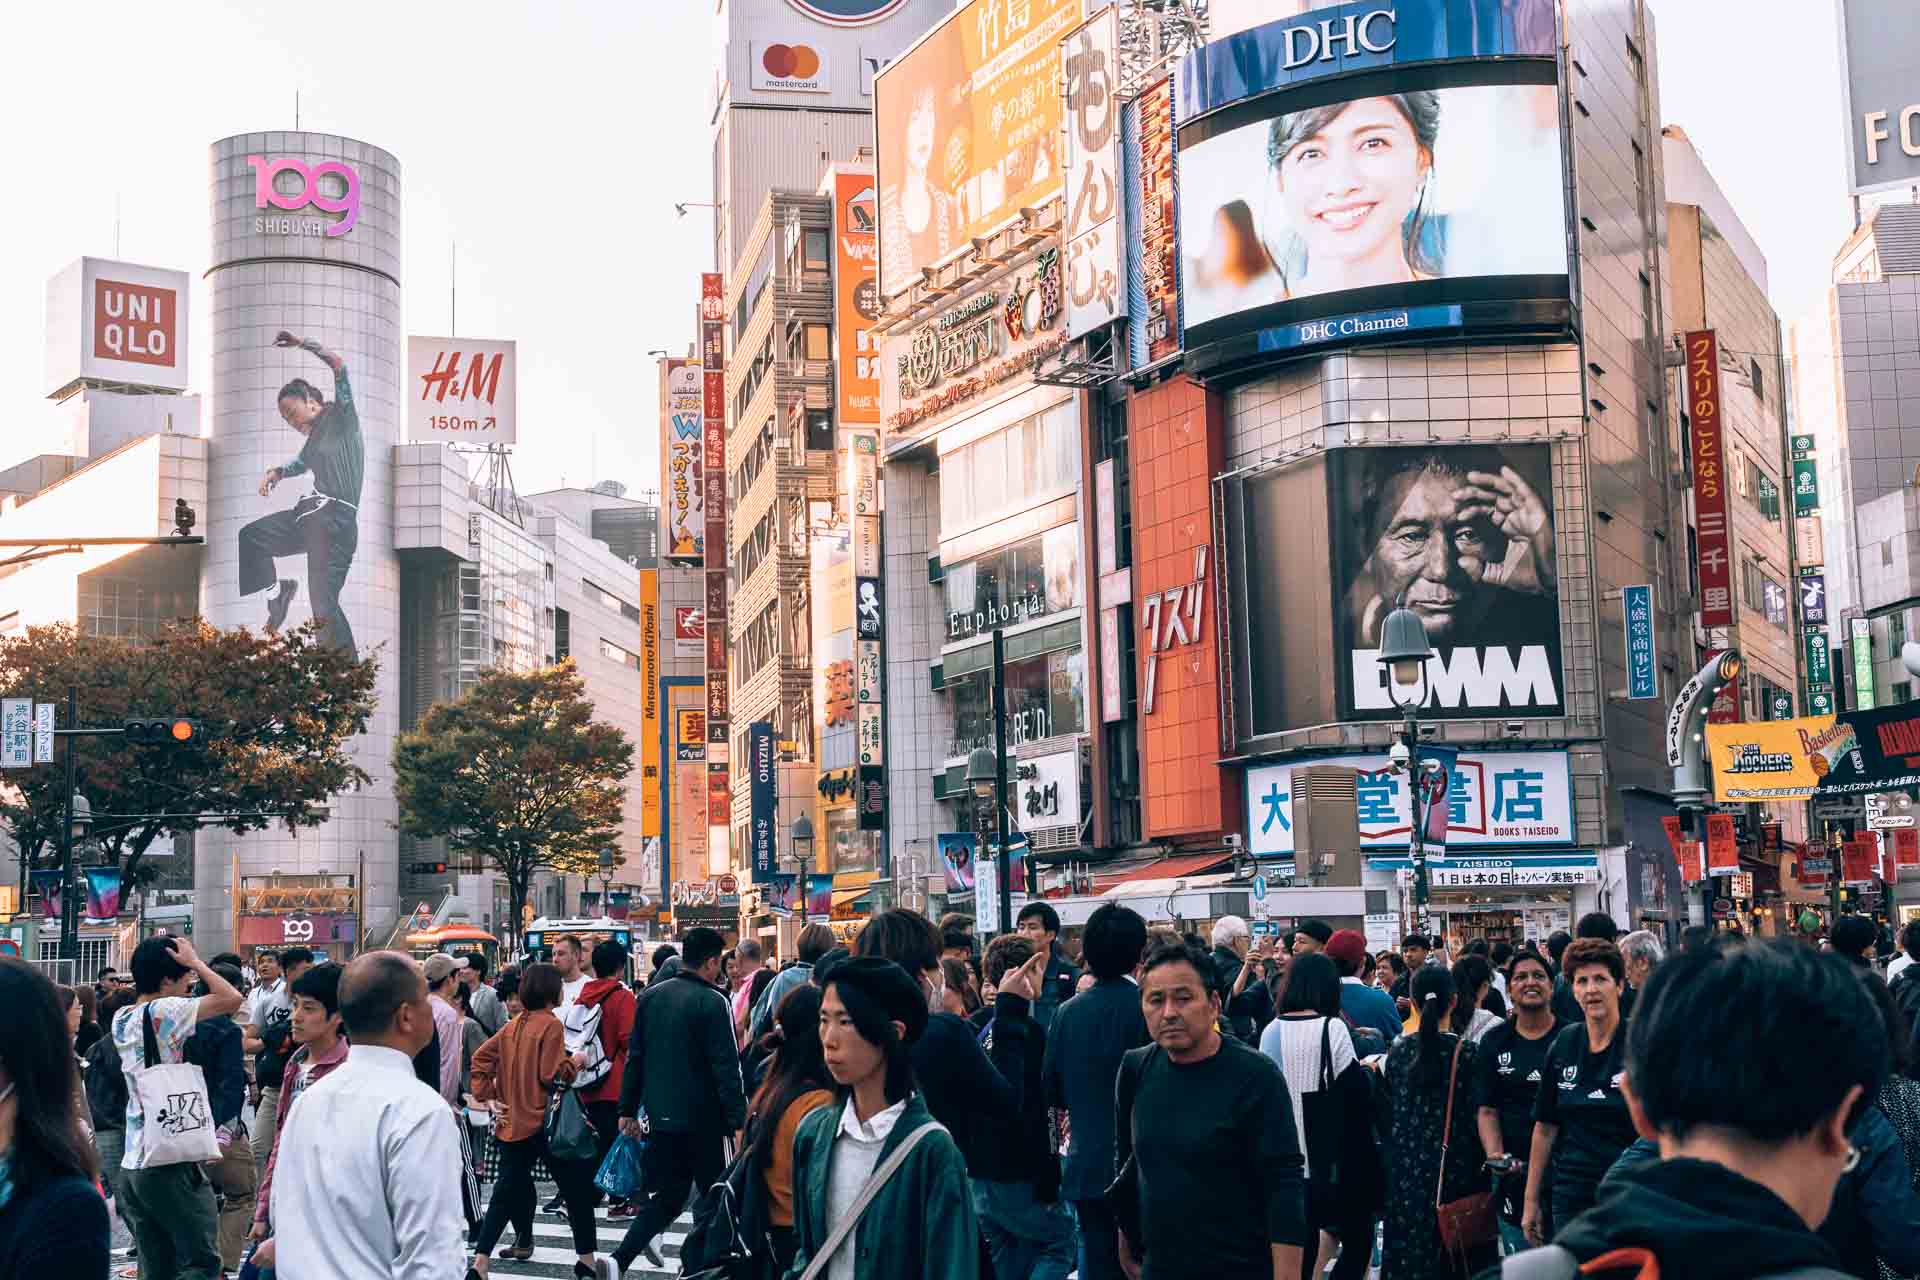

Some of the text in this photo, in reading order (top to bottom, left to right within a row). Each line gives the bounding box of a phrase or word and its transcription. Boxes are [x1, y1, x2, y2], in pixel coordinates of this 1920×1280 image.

[1282, 9, 1396, 70] DHC
[765, 80, 818, 89] mastercard
[1066, 29, 1118, 314] もんじゃ
[247, 153, 360, 237] 109
[256, 216, 320, 236] SHIBUYA
[104, 290, 161, 324] UNI
[1301, 313, 1409, 341] DHC Channel
[104, 323, 166, 356] QLO
[421, 351, 504, 405] H&M
[429, 416, 477, 431] 150m
[1691, 339, 1729, 612] クスリのことなら 三千里
[950, 592, 1041, 636] Euphoria
[1143, 544, 1206, 714] クスリ
[1631, 592, 1649, 691] 大盛堂商事ビル
[646, 650, 655, 720] Matsumoto
[860, 658, 869, 688] パーラー
[870, 652, 878, 684] フルーツ
[15, 703, 28, 761] 渋谷駅前
[1670, 681, 1698, 763] 渋谷センター街
[759, 736, 769, 783] MIZUHO
[757, 819, 769, 871] みずほ銀行
[1494, 826, 1559, 837] BOOKS TAISEIDO
[1439, 871, 1584, 885] 1日は本の日 キャンペーン実施中
[282, 920, 314, 941] 109
